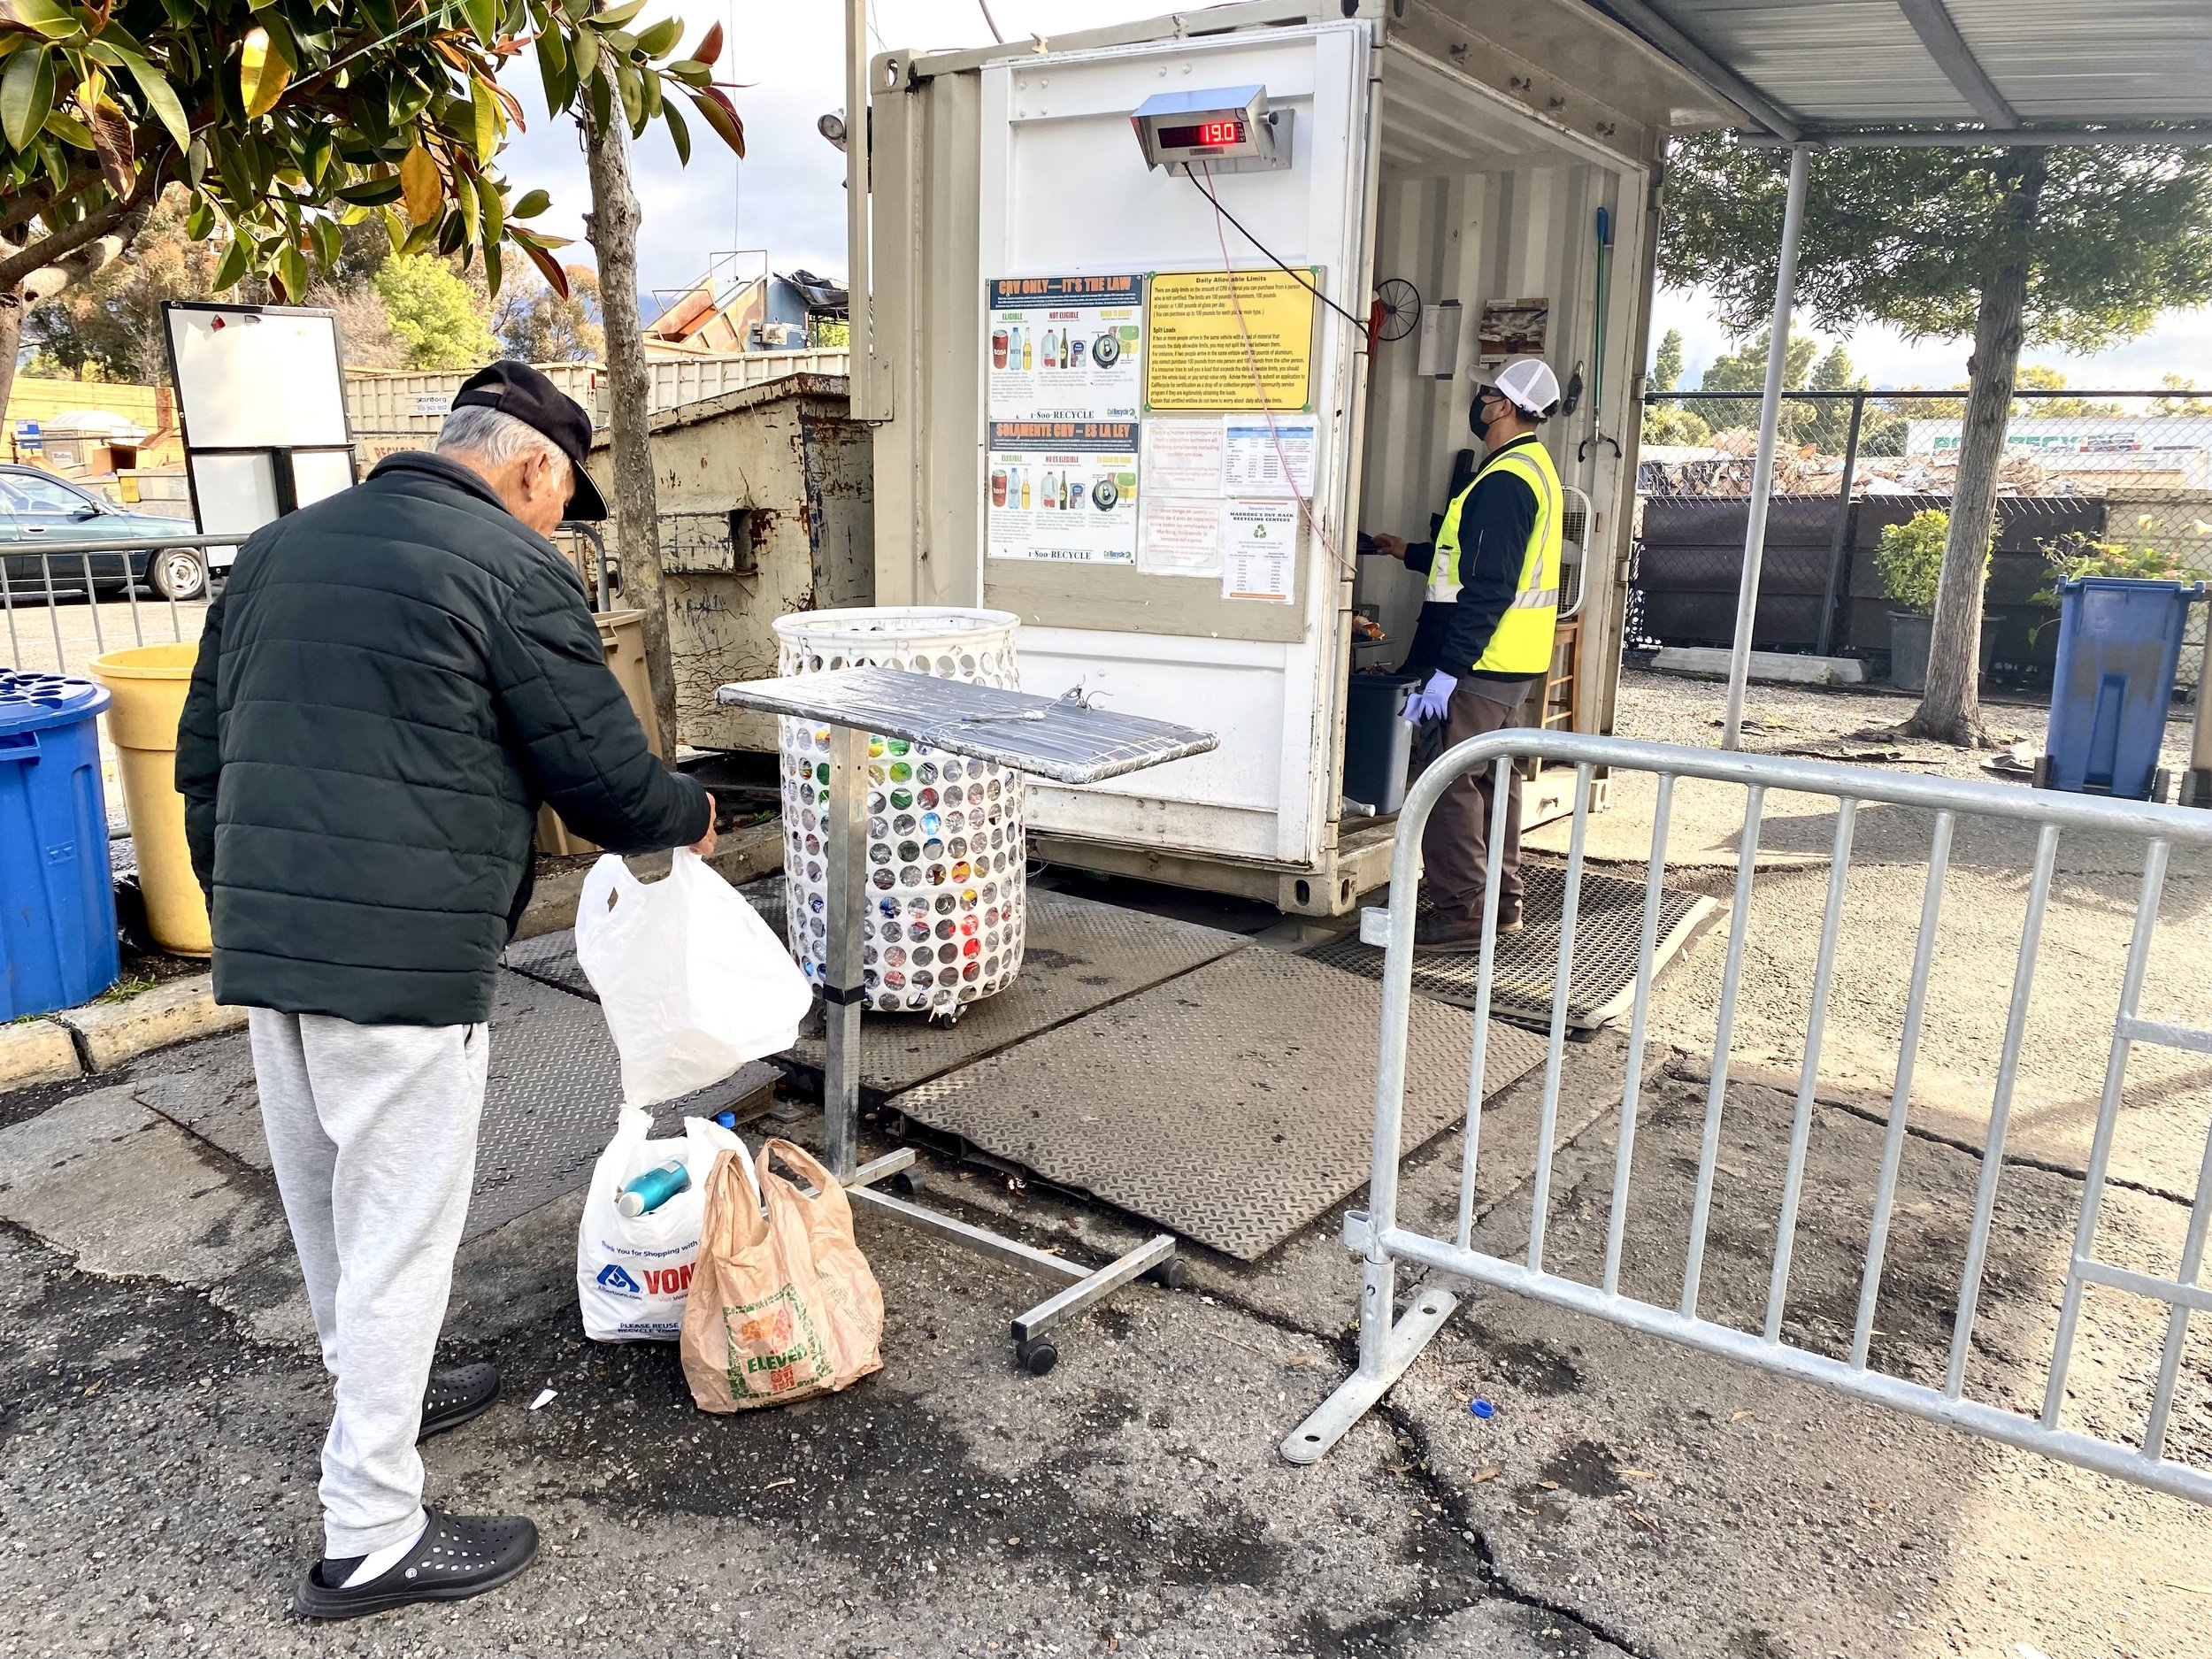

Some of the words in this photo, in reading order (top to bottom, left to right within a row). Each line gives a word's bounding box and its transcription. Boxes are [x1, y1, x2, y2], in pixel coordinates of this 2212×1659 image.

[1205, 124, 1234, 142] 19.0
[998, 280, 1021, 294] CRV
[1085, 277, 1105, 291] THE
[1107, 276, 1132, 291] LAW
[996, 423, 1052, 437] SOLAMENTE
[1054, 424, 1075, 437] CRV
[1085, 424, 1097, 437] ES
[1099, 424, 1113, 437] LA
[1114, 424, 1130, 437] LEY
[1028, 550, 1091, 559] 1-800-RECYCLE
[602, 1240, 615, 1252] Thank
[643, 1248, 680, 1257] Shopping
[681, 1240, 698, 1250] with
[597, 1285, 642, 1302] Albertsons.com
